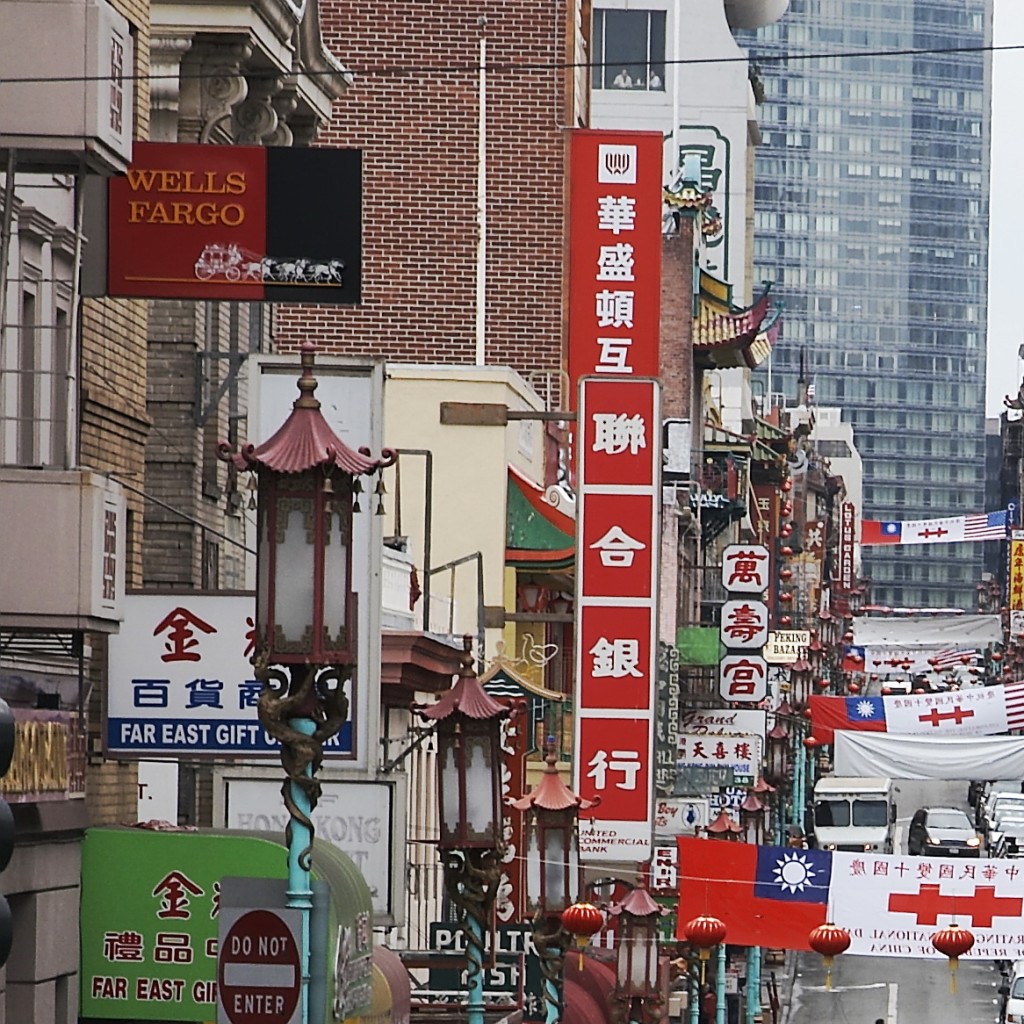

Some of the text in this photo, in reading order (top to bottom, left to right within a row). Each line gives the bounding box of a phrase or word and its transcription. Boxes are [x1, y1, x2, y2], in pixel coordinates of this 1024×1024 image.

[127, 169, 247, 195] WELLS
[128, 201, 245, 227] FARGO
[723, 550, 768, 696] 萬壽宮
[774, 631, 807, 643] PEKING
[131, 678, 320, 710] 百貨商
[120, 723, 156, 744] FAR
[162, 724, 211, 744] EAST
[216, 725, 260, 745] GIFT
[152, 871, 221, 921] 金
[231, 935, 289, 956] DO NOT
[92, 975, 127, 999] FAR
[136, 978, 184, 1002] EAST
[233, 993, 285, 1015] ENTER
